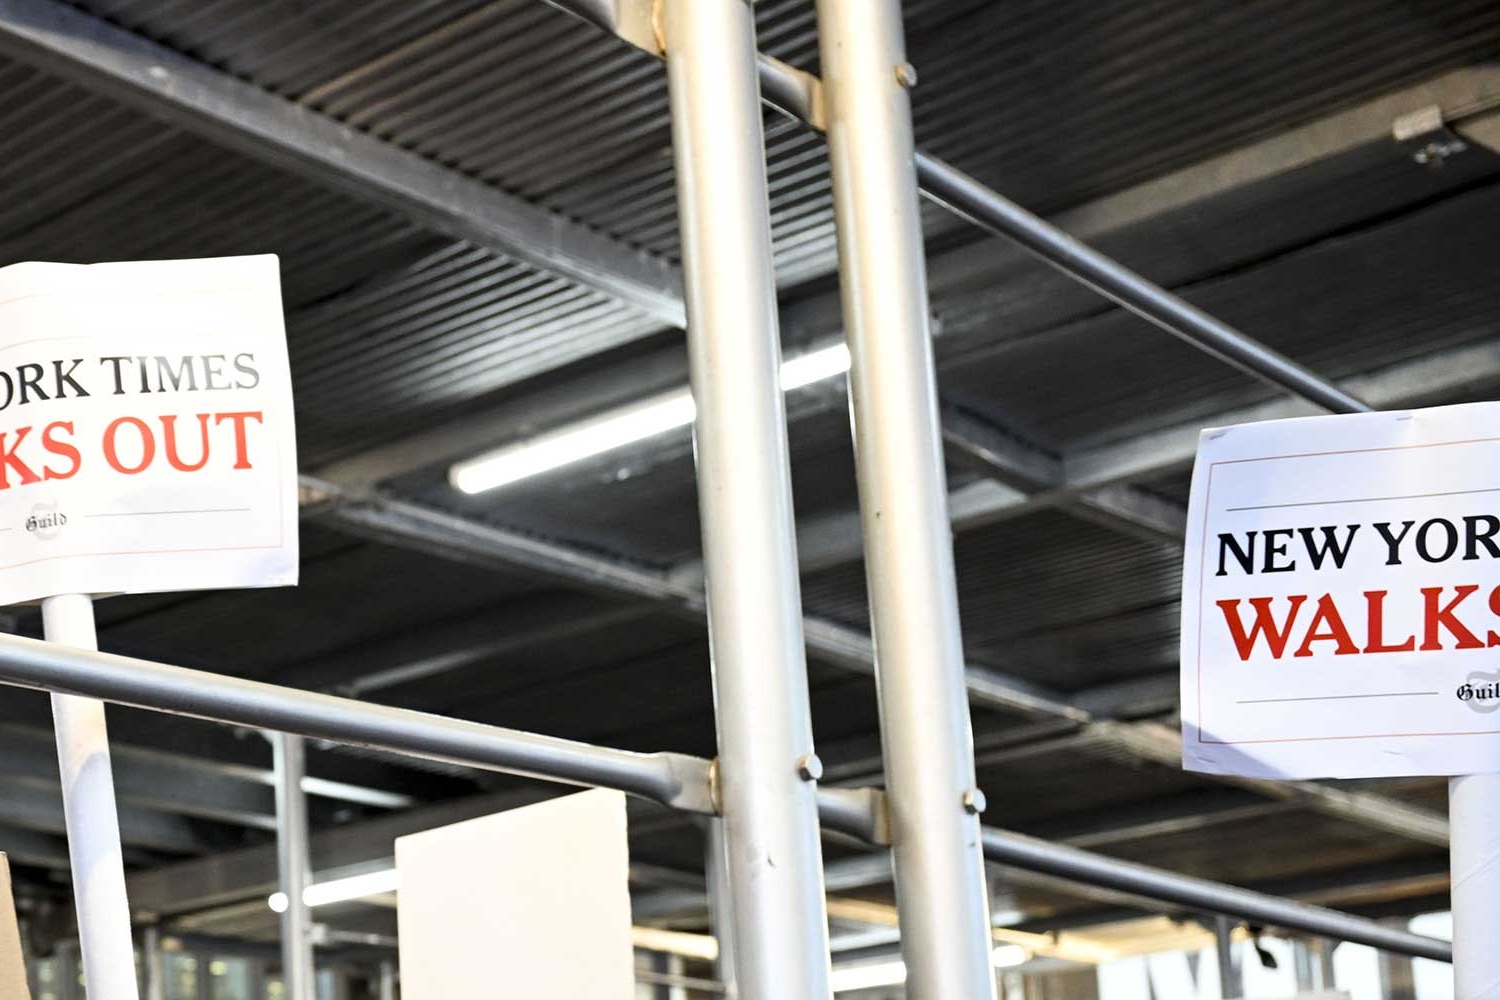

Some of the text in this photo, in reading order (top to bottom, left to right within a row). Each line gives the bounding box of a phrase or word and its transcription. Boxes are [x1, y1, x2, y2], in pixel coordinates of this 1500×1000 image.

[99, 352, 261, 395] TIMES
[102, 411, 264, 475] OUT
[25, 512, 68, 533] Guild
[1215, 524, 1361, 577] NEW
